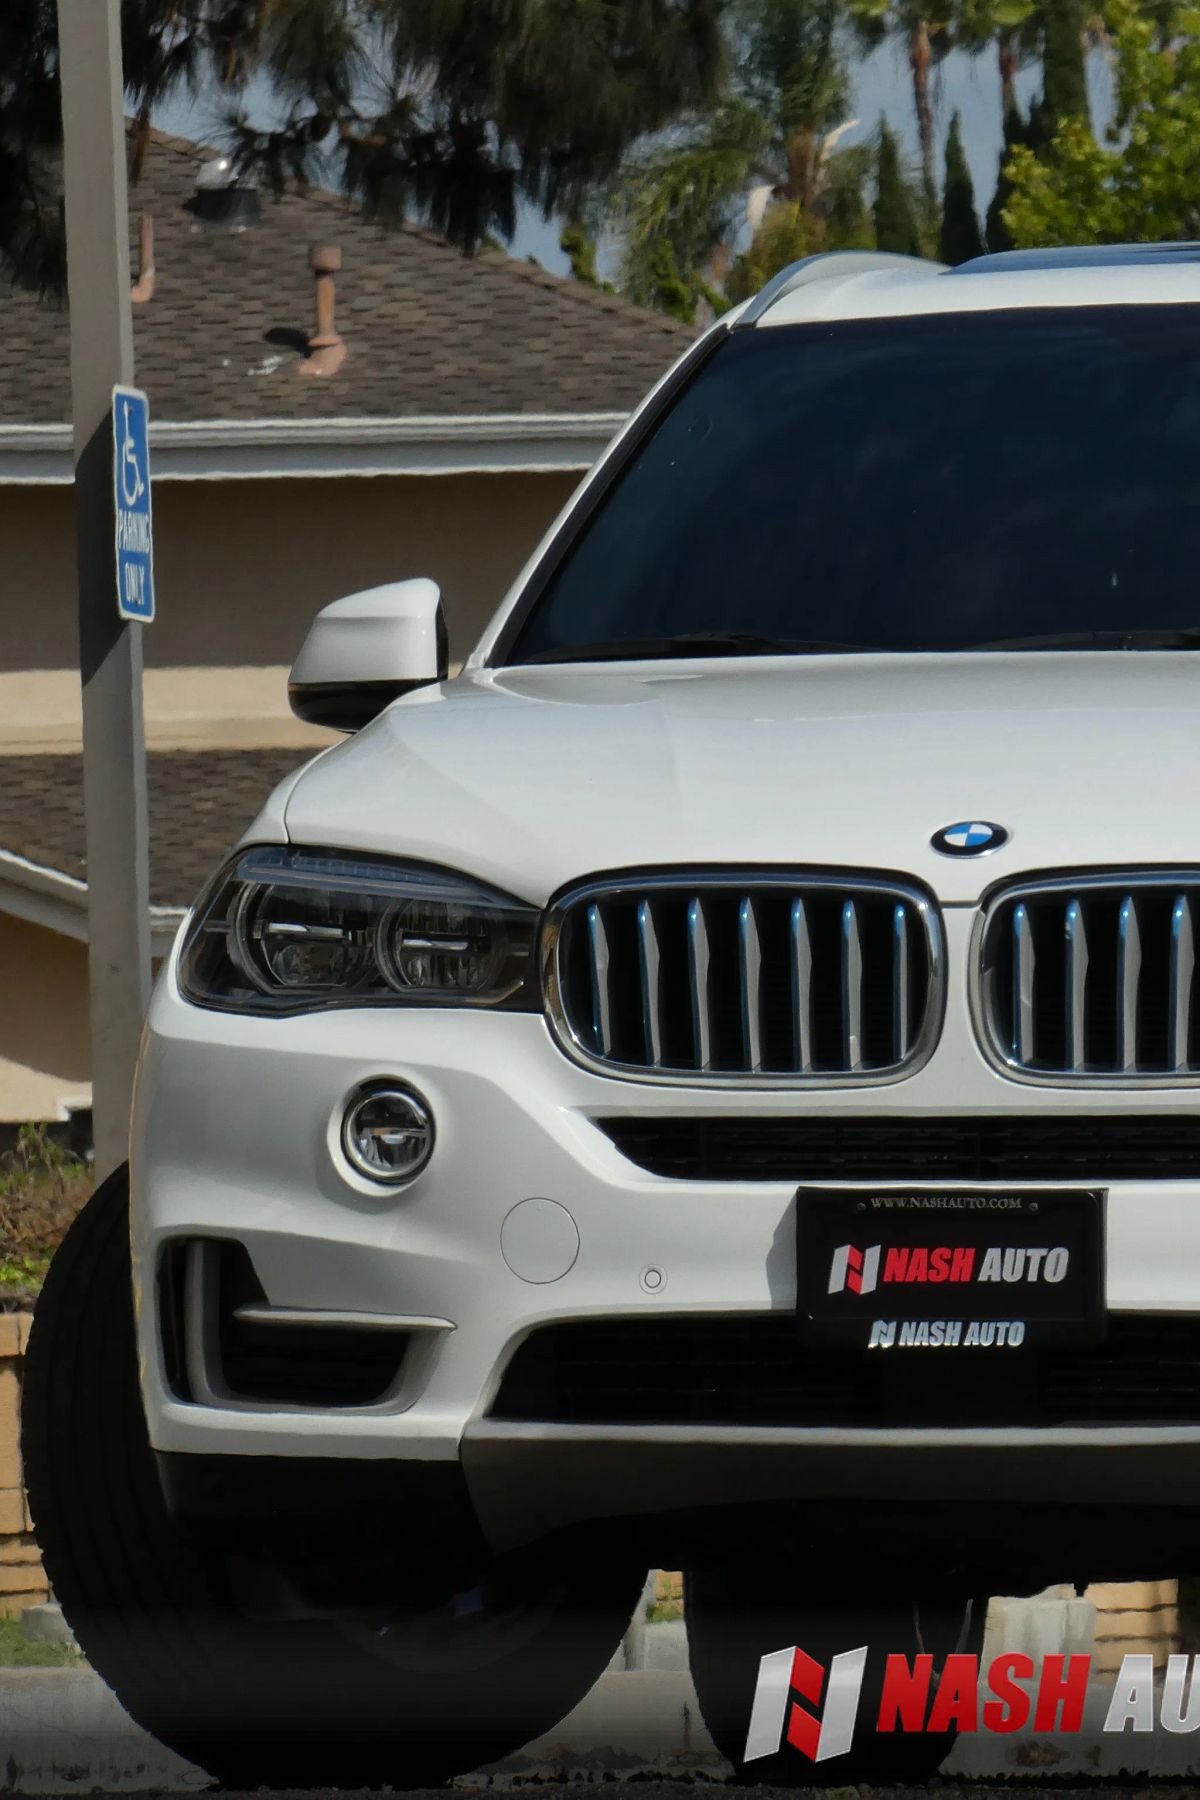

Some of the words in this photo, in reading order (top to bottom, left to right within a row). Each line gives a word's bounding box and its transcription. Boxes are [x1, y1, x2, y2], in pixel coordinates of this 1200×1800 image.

[125, 562, 145, 604] ONLY
[870, 1197, 1022, 1209] WWW.NASHAUTO.COM
[883, 1248, 976, 1282] NASH
[978, 1247, 1069, 1283] AUTO
[899, 1321, 963, 1347] NASH
[963, 1321, 1026, 1347] AUTO
